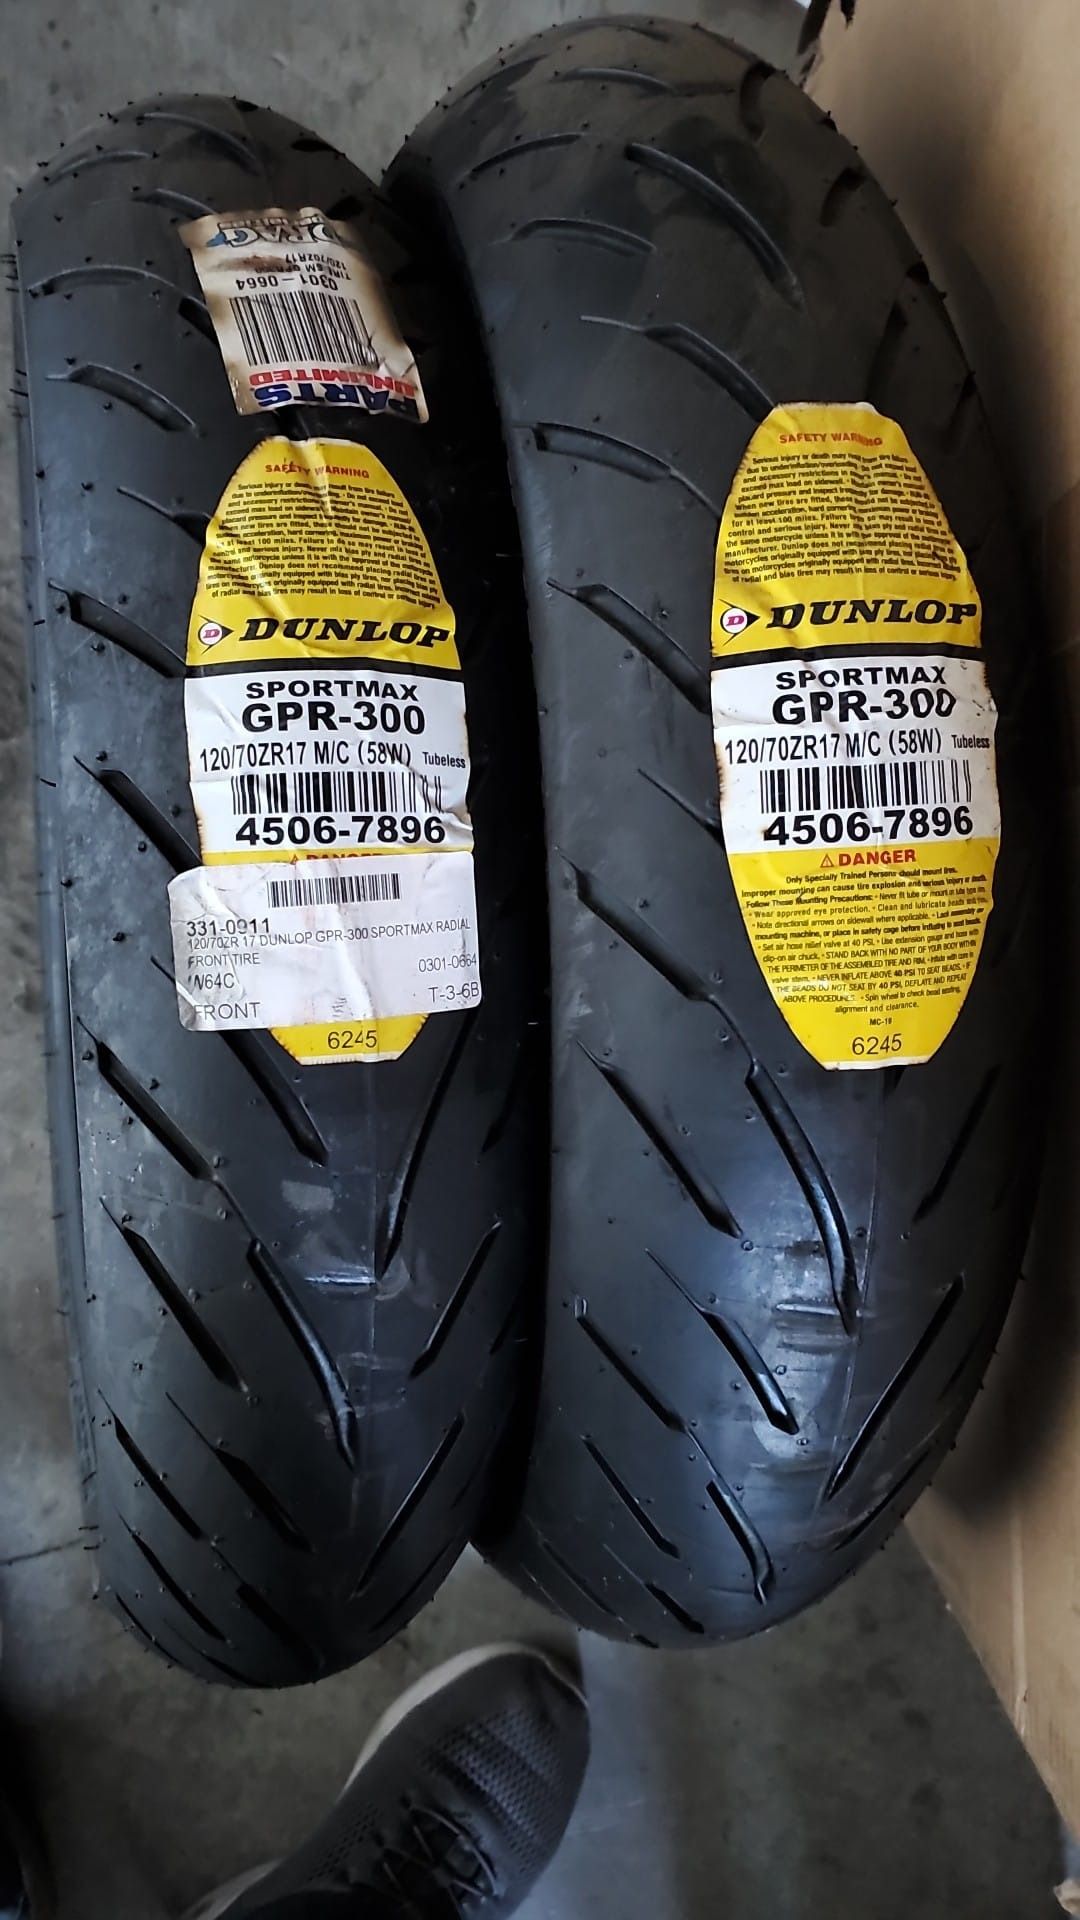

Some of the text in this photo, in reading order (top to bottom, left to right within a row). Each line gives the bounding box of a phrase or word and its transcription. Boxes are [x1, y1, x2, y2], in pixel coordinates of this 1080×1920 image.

[235, 275, 279, 290] 0664
[300, 274, 339, 291] 0301
[249, 368, 417, 397] UNLIMITED
[252, 382, 420, 420] PARTS
[779, 433, 827, 444] SAFETY
[820, 513, 847, 521] Failure
[782, 541, 809, 551] Dunlop
[766, 599, 978, 630] DUNLOP
[238, 616, 450, 648] DUNLOP
[776, 666, 947, 690] SPORTMAX
[246, 680, 419, 701] SPORTMAX
[241, 700, 425, 735] GPR-300
[772, 688, 957, 726] GPR-300
[200, 740, 466, 772] 120/70ZR17 M/C (58W) Tubeless
[725, 727, 990, 765] 120/70ZR17 M/C (58W) Tubeless
[235, 815, 446, 846] 4506-7896
[763, 805, 973, 847] 4506-7896
[838, 849, 917, 867] DANGER
[840, 871, 866, 880] Trained
[741, 890, 776, 898] Improper
[186, 917, 270, 937] 331-0911
[243, 934, 255, 948] 17
[259, 932, 314, 947] DUNLOP
[315, 928, 369, 942] GPR-300
[371, 922, 433, 939] SPORTMAX
[436, 918, 472, 933] RADIAL
[187, 952, 261, 969] FRONT TIRE
[418, 954, 477, 974] 0301-0664
[825, 950, 849, 960] STAND
[850, 949, 869, 958] BACK
[428, 981, 480, 1003] T-3-6B
[878, 981, 889, 989] 40
[194, 1001, 261, 1021] FRONT
[869, 1000, 920, 1012] and clearance.
[327, 1029, 378, 1051] 6245
[852, 1033, 902, 1055] 6245
